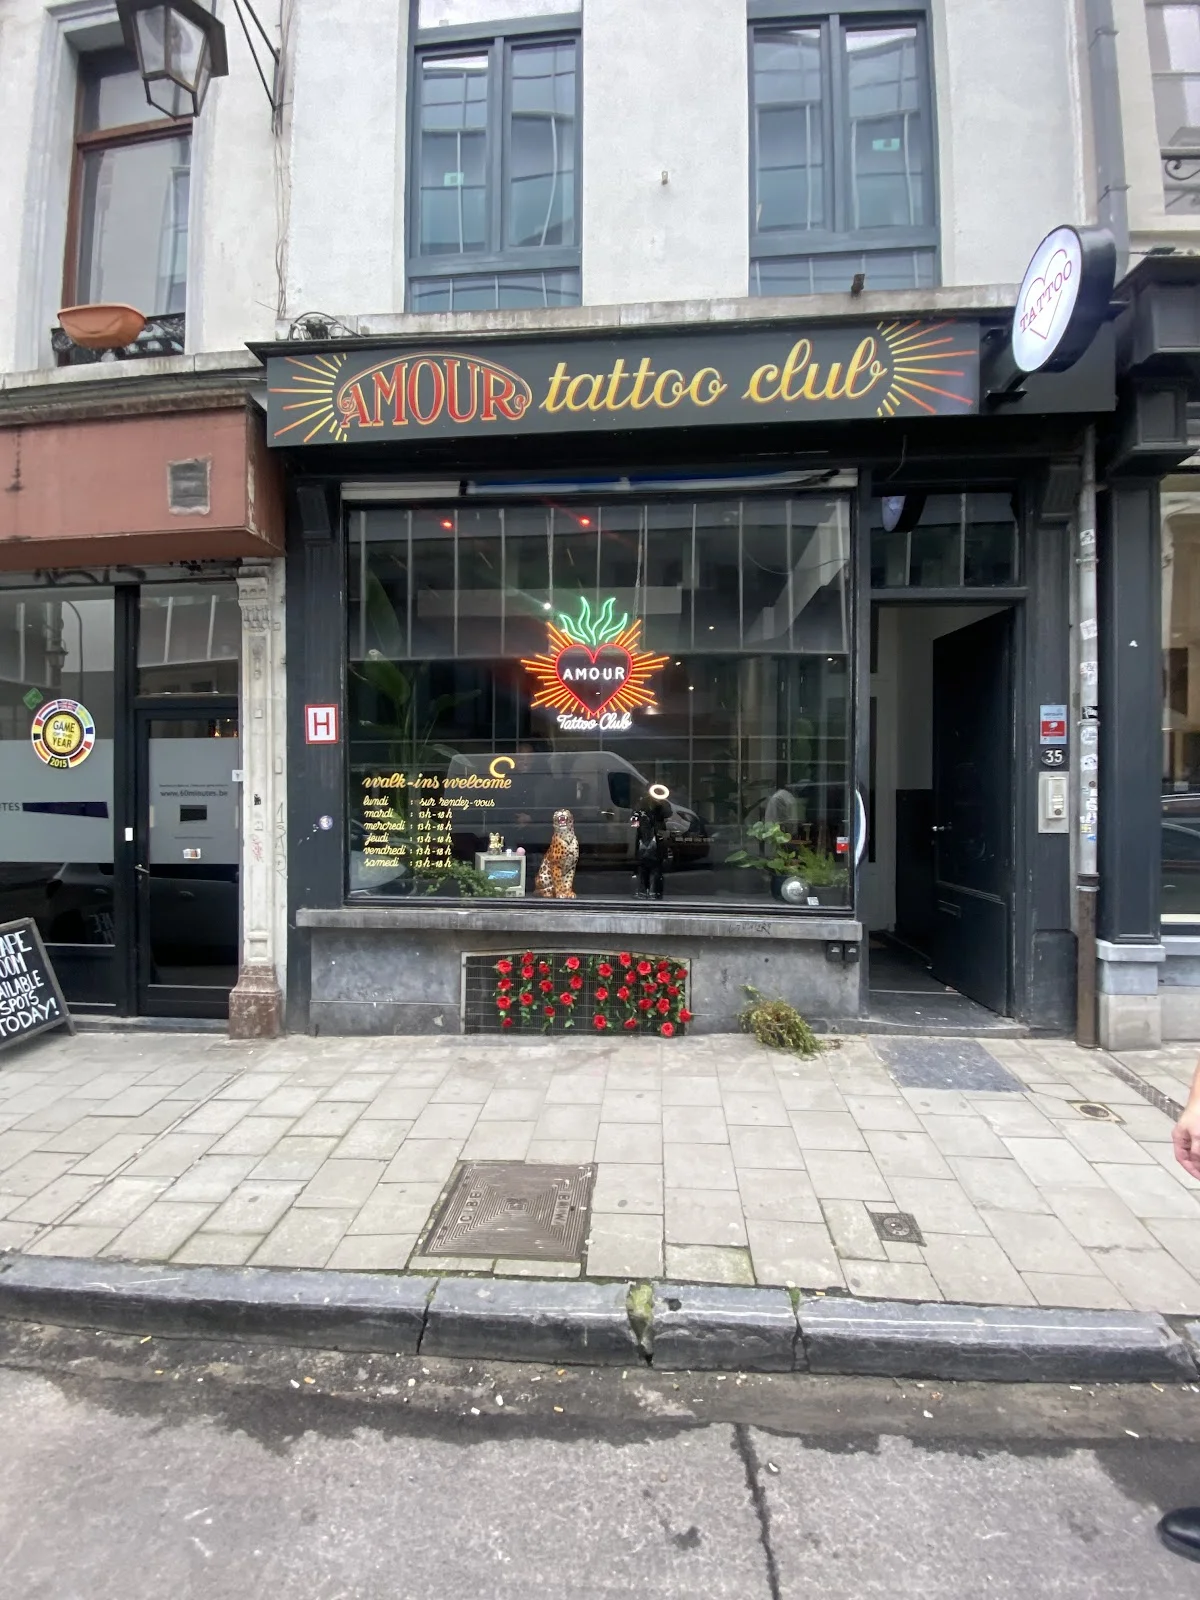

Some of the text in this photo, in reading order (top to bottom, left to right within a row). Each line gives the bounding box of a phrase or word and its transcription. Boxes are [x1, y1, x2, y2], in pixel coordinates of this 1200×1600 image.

[1020, 260, 1072, 333] TATTOO
[339, 336, 888, 428] AMOUR tattoo club
[563, 667, 625, 680] AMOUR
[53, 720, 75, 733] GAME
[314, 712, 329, 736] H
[557, 712, 632, 730] Tattoo Club
[52, 737, 72, 748] YEAR
[50, 757, 68, 768] 2015
[1045, 749, 1063, 763] 35
[362, 772, 512, 789] walk-ins welcome
[160, 789, 228, 797] www.60minutes.be
[0, 802, 20, 811] TES
[363, 795, 389, 806] lundi
[419, 798, 436, 807] sur
[438, 796, 496, 810] rendez-vous
[364, 808, 394, 818] mardi
[363, 820, 406, 831] mercredi
[365, 833, 389, 845] jeudi
[363, 845, 407, 855] vendredi
[364, 857, 400, 867] samedi
[0, 990, 39, 1015] SPOTS
[0, 997, 60, 1036] TODAY!
